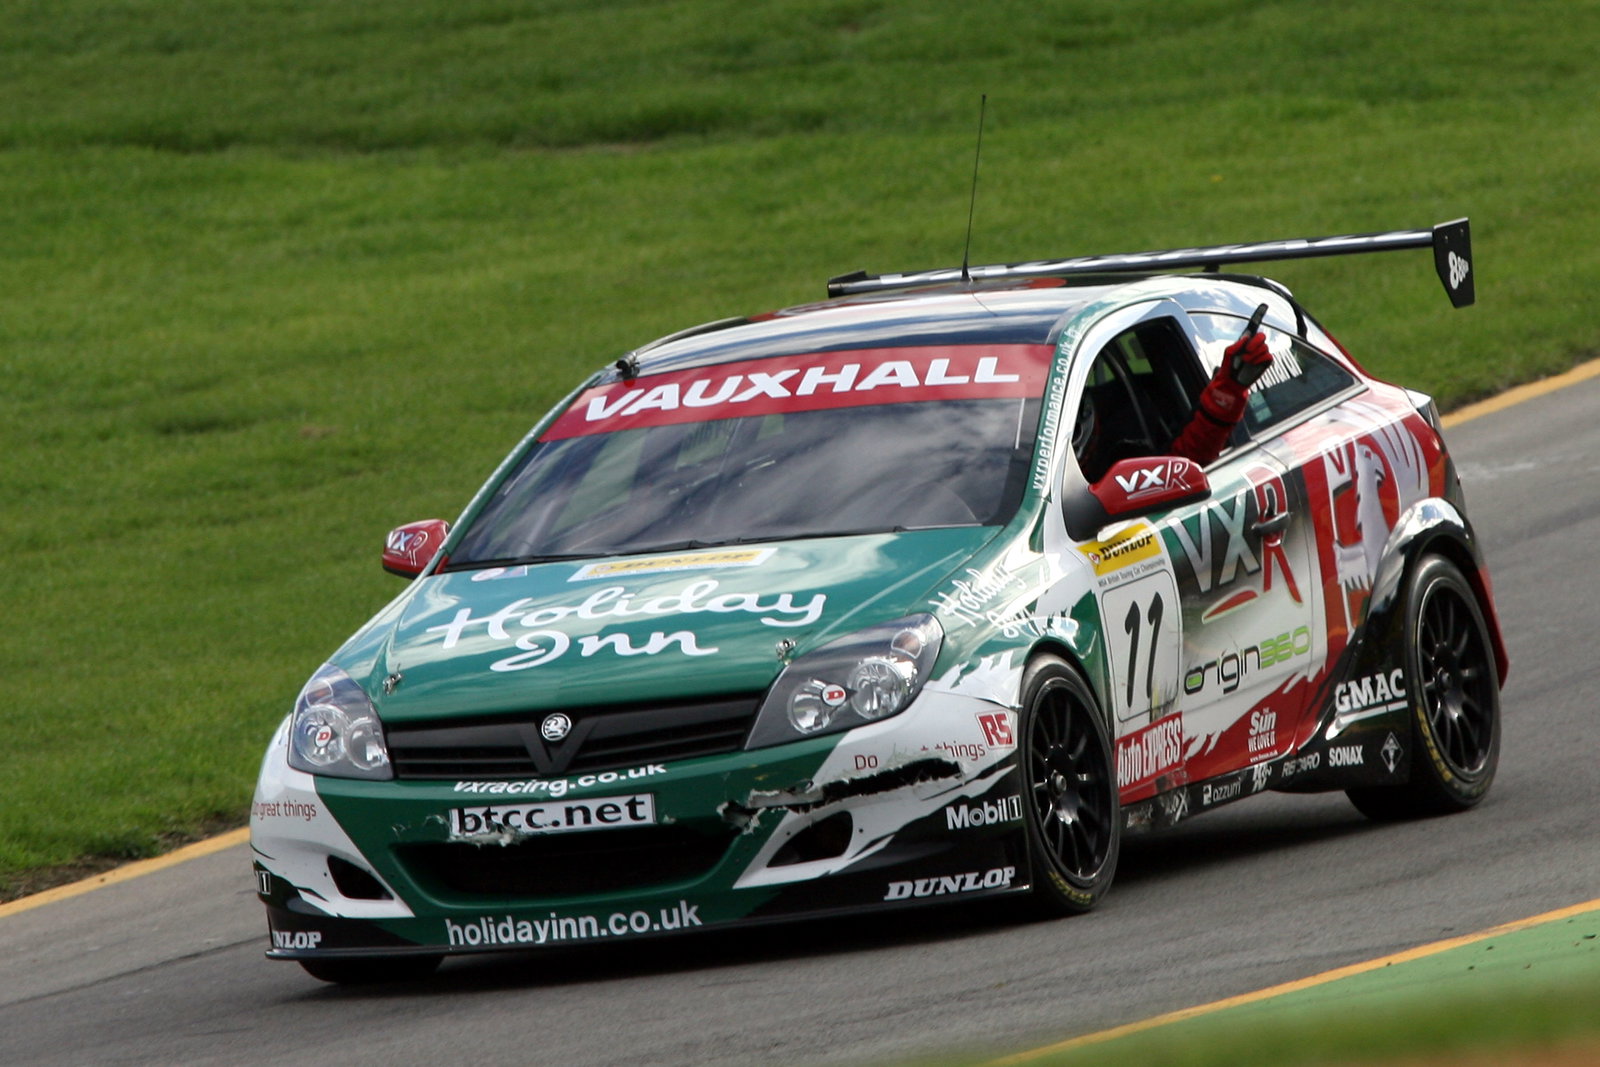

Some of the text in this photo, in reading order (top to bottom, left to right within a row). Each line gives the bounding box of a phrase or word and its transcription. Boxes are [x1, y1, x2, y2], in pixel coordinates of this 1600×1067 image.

[585, 356, 1020, 421] VAUXHALL
[1115, 460, 1192, 491] VXR
[387, 530, 429, 567] VXR
[1099, 532, 1154, 561] DUNLOP
[1166, 462, 1303, 605] VXR
[427, 579, 827, 648] Holiday
[489, 630, 719, 672] Inn
[1124, 591, 1164, 708] 11
[1335, 668, 1406, 713] GMAC
[854, 754, 878, 771] Do
[1142, 717, 1181, 778] EXPRESS
[1282, 752, 1320, 777] REARO
[1329, 745, 1364, 767] SONAX
[453, 764, 668, 797] vxracing.co.uk
[284, 799, 317, 821] things
[457, 796, 647, 835] btcc.net
[946, 798, 1008, 829] Mobil
[884, 866, 1016, 900] DUNLOP
[271, 931, 322, 950] NLOP
[445, 900, 703, 946] holidayinn.co.uk
